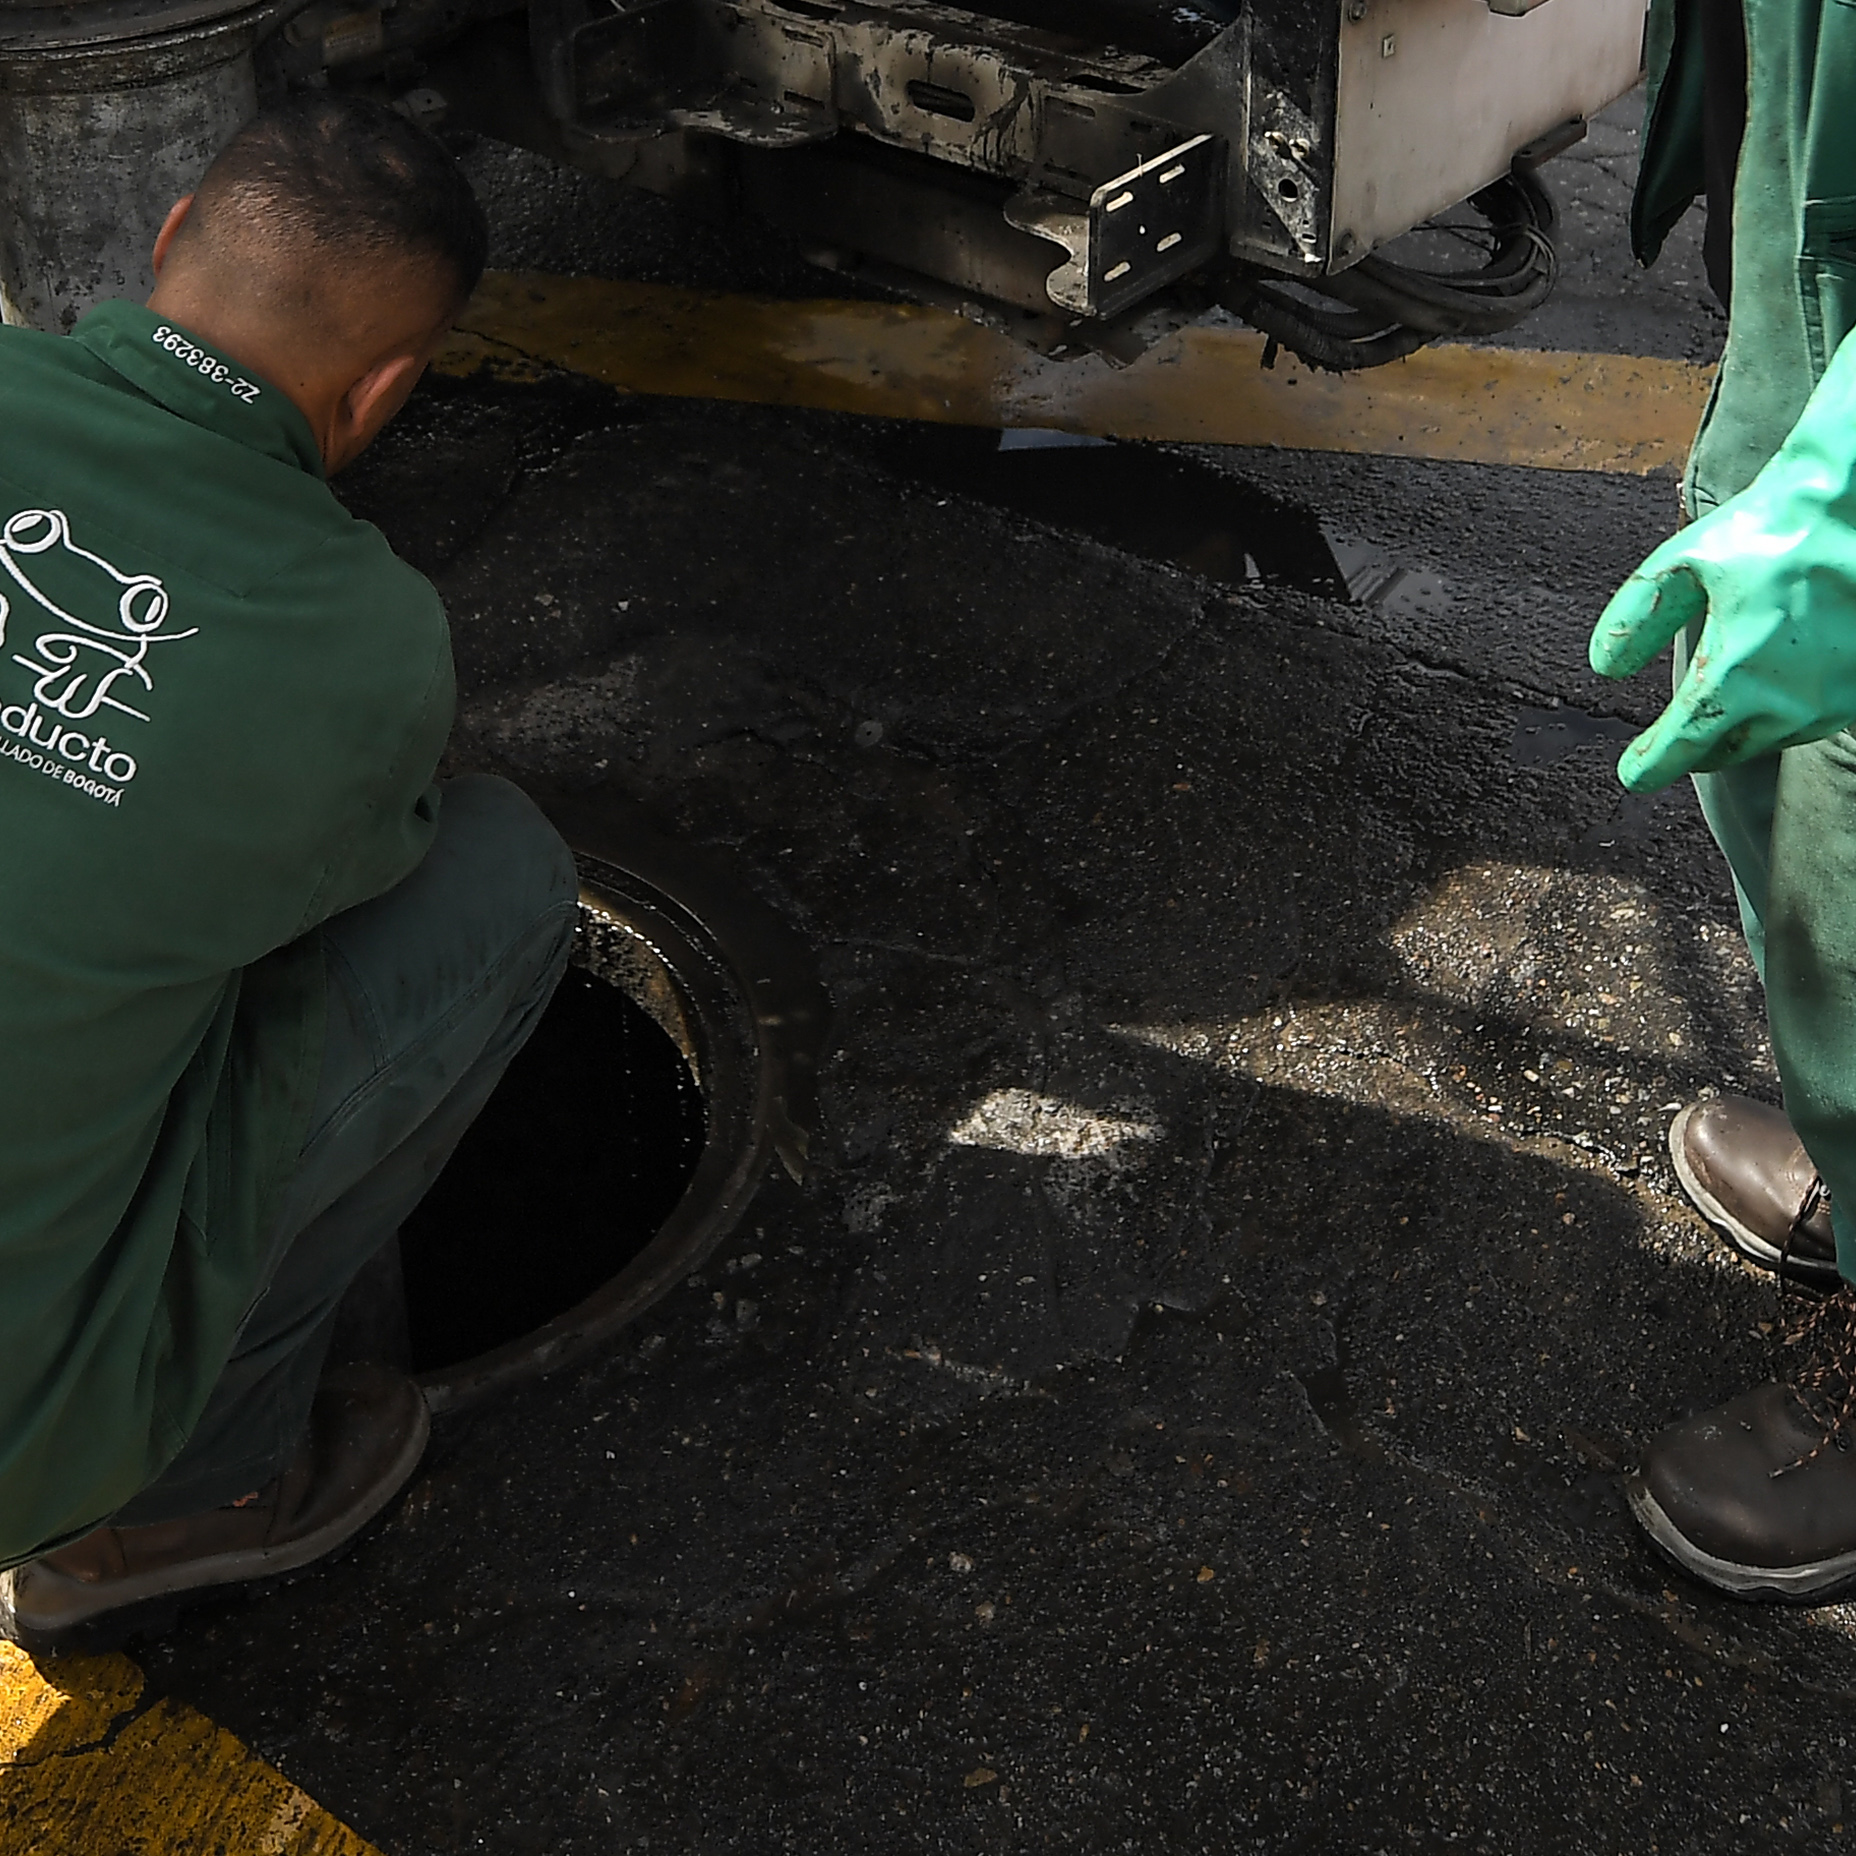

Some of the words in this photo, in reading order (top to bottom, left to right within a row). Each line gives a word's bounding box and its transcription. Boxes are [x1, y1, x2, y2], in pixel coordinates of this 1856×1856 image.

[152, 326, 261, 405] Z2-383293
[43, 759, 64, 779] DE
[63, 768, 125, 807] BOGOTÁ
